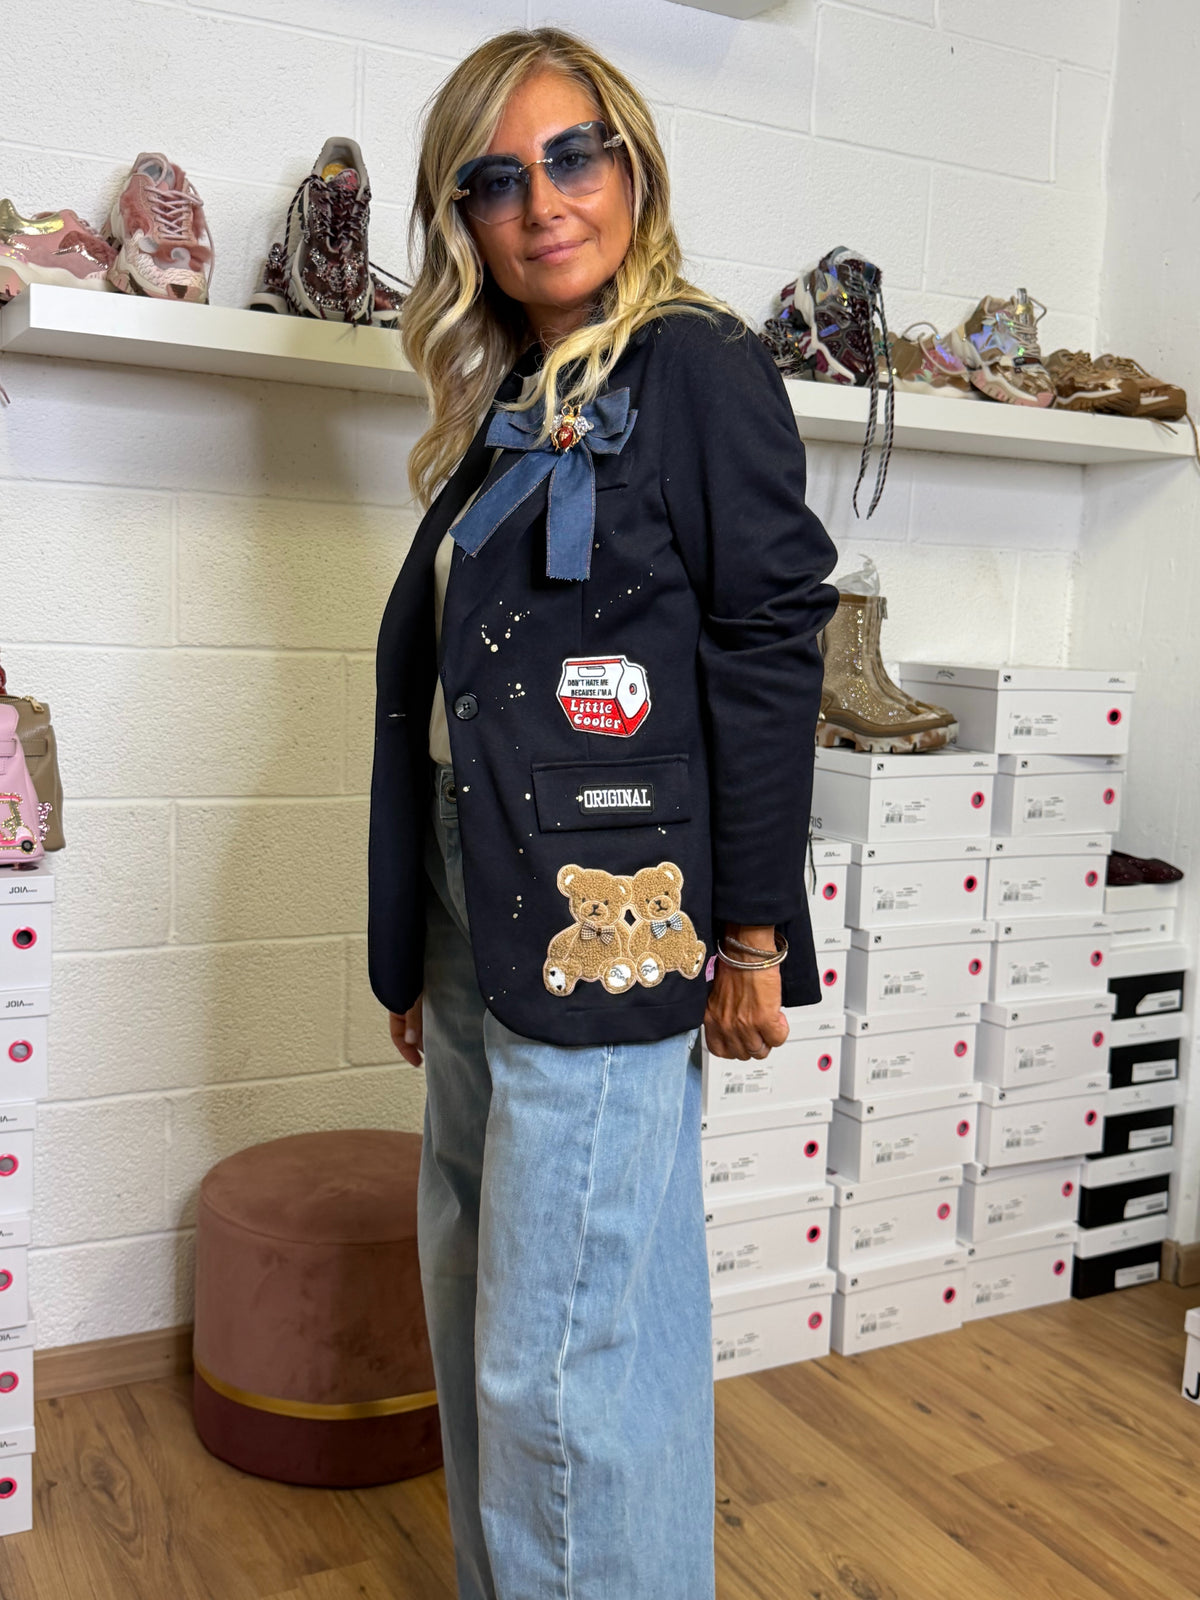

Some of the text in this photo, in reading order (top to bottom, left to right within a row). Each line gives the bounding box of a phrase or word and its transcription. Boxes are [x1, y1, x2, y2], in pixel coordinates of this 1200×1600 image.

[570, 699, 612, 714] Little
[573, 713, 621, 729] Cooler
[583, 788, 651, 808] ORIGINAL
